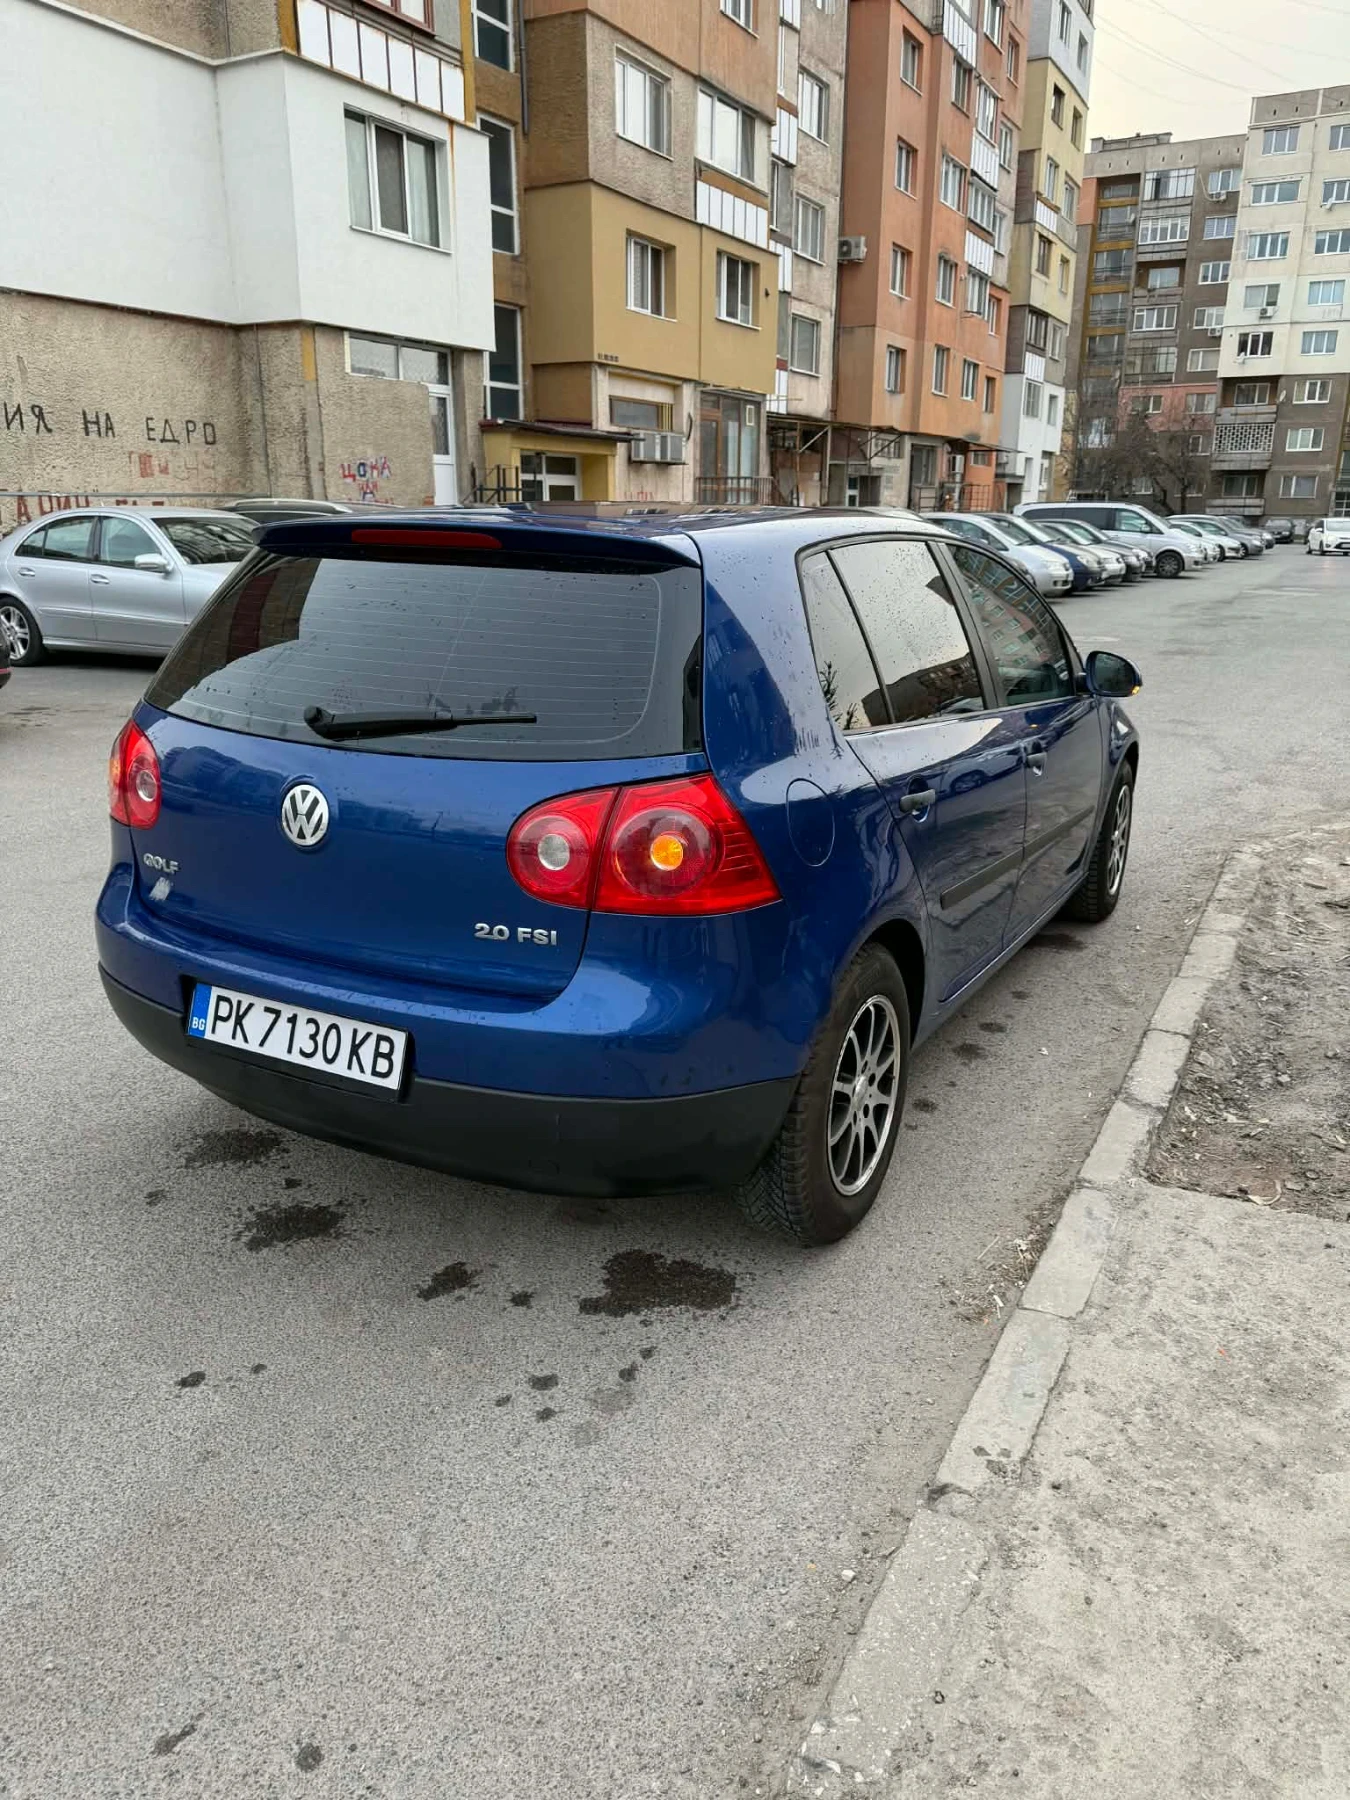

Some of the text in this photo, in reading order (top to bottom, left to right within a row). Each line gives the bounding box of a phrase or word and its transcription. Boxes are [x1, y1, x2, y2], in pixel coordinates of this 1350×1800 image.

[82, 409, 115, 438] НА
[146, 416, 217, 445] ЕДРО
[281, 784, 329, 846] VW
[143, 852, 179, 874] GOLF
[517, 927, 557, 946] FSI
[192, 1017, 205, 1030] BG
